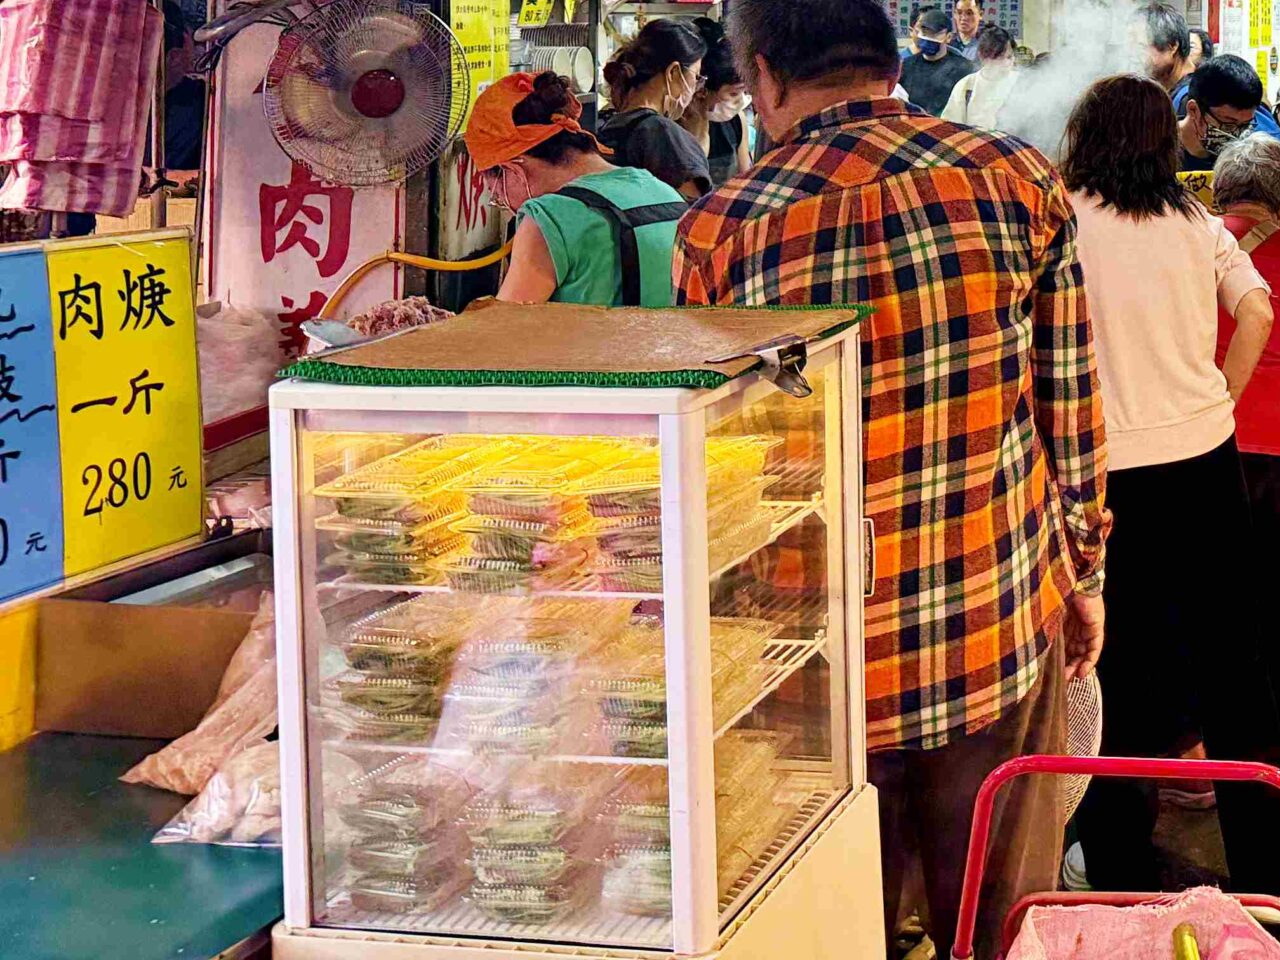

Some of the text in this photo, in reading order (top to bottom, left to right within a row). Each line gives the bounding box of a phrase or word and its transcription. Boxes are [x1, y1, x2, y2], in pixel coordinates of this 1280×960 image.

[57, 263, 176, 341] 肉焿
[70, 368, 165, 416] 一斤
[81, 451, 188, 517] 280 元
[25, 532, 48, 556] 元
